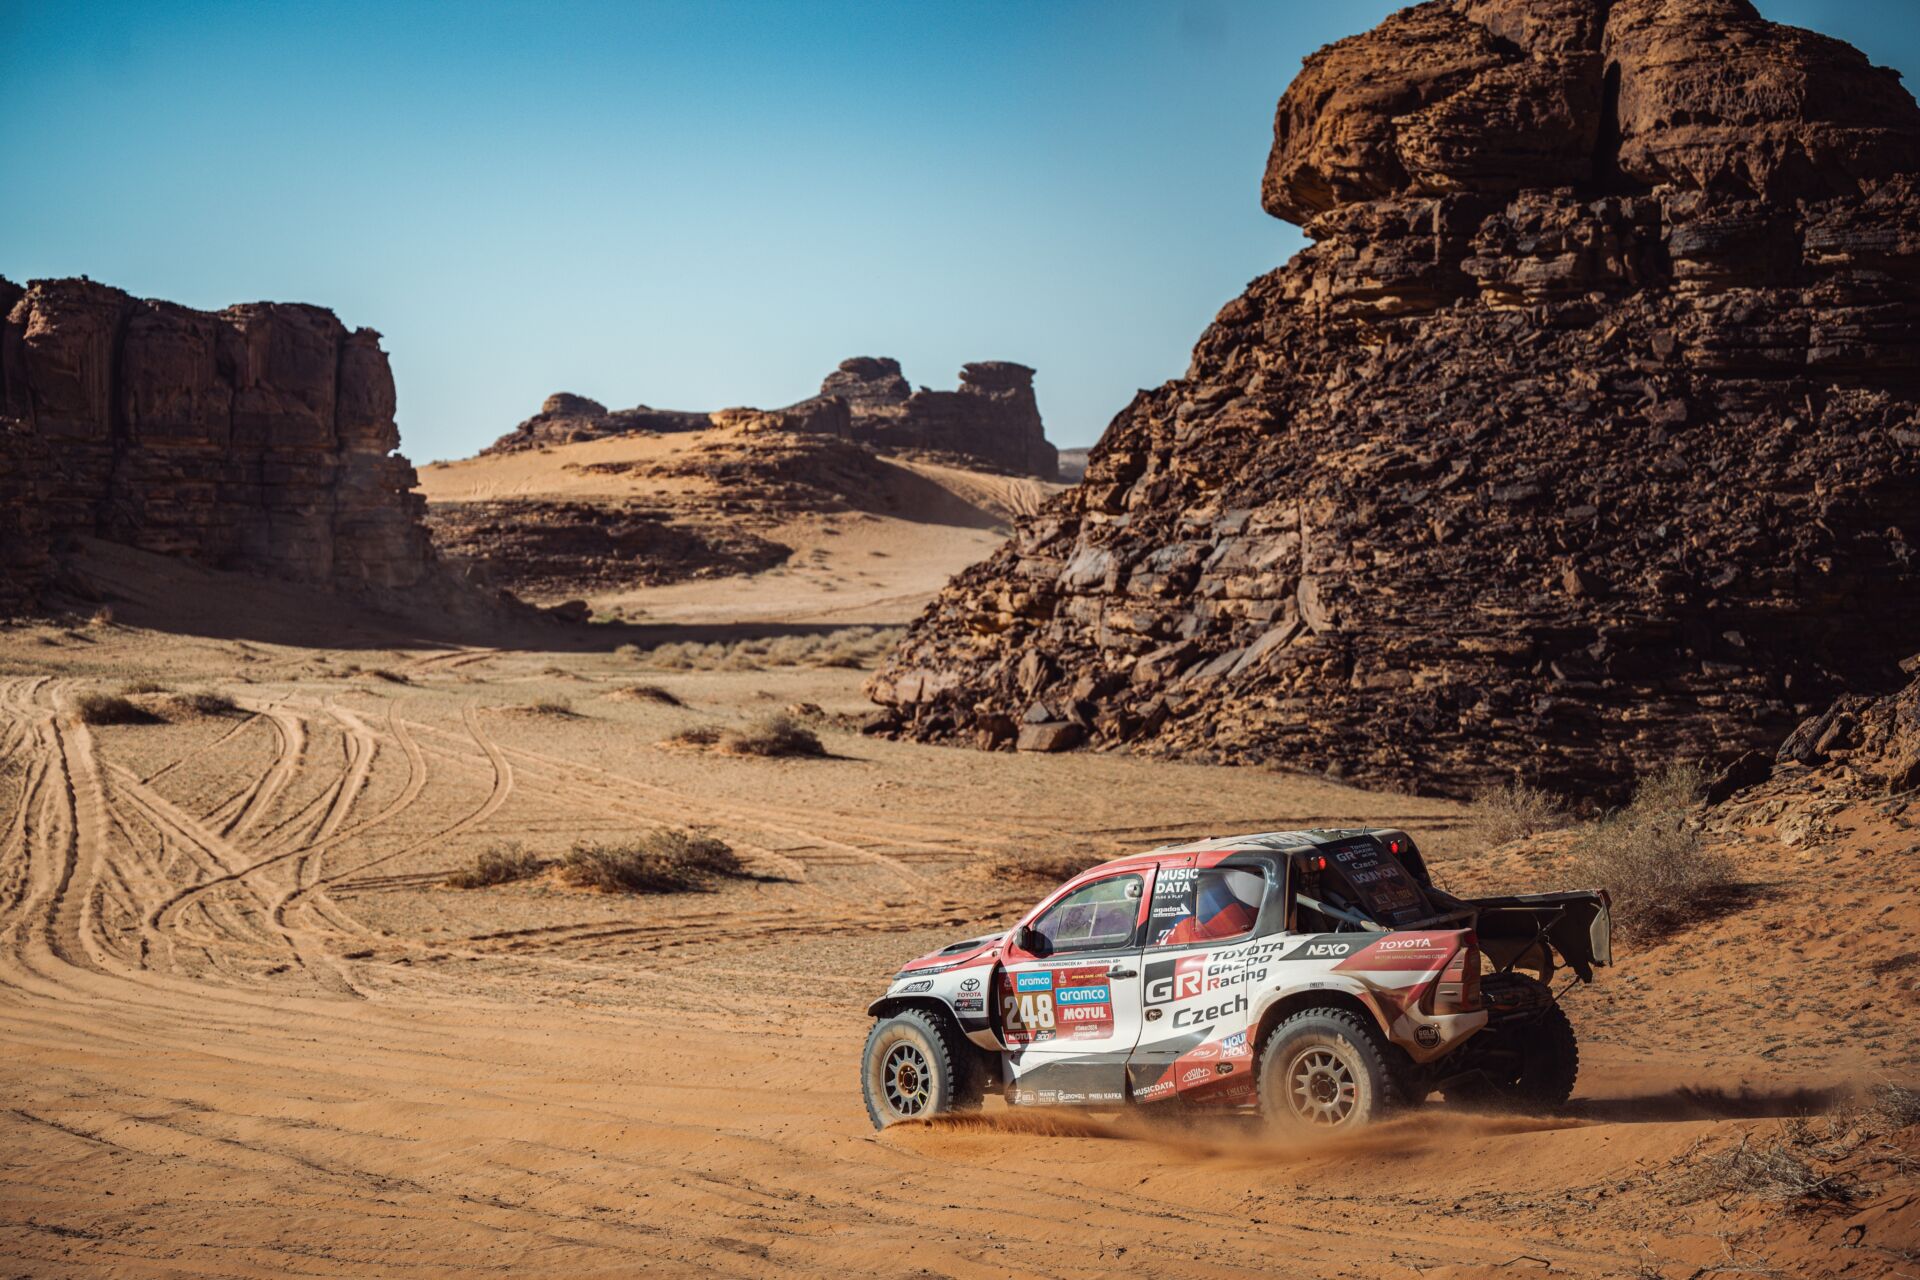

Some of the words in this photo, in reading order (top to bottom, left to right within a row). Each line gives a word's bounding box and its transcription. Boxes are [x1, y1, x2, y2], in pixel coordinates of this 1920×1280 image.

[1336, 851, 1357, 862] GR
[1352, 860, 1378, 870] Czech
[1157, 868, 1200, 880] MUSIC
[1156, 881, 1192, 894] DATA
[1306, 944, 1350, 956] NEXO
[1380, 938, 1431, 950] TOYOTA
[1212, 942, 1284, 961] TOYOTA
[1208, 955, 1272, 976] GAZOO
[1020, 977, 1050, 986] aramco
[1208, 968, 1268, 991] Racing
[1146, 970, 1201, 1004] GR
[1060, 989, 1106, 1001] aramco
[1004, 994, 1055, 1030] 248
[1064, 1006, 1106, 1020] MOTUL
[1172, 994, 1248, 1028] Czech
[1223, 1032, 1246, 1048] LIQUI
[1222, 1045, 1247, 1058] MOLY
[1132, 1081, 1174, 1097] MUSICDATA
